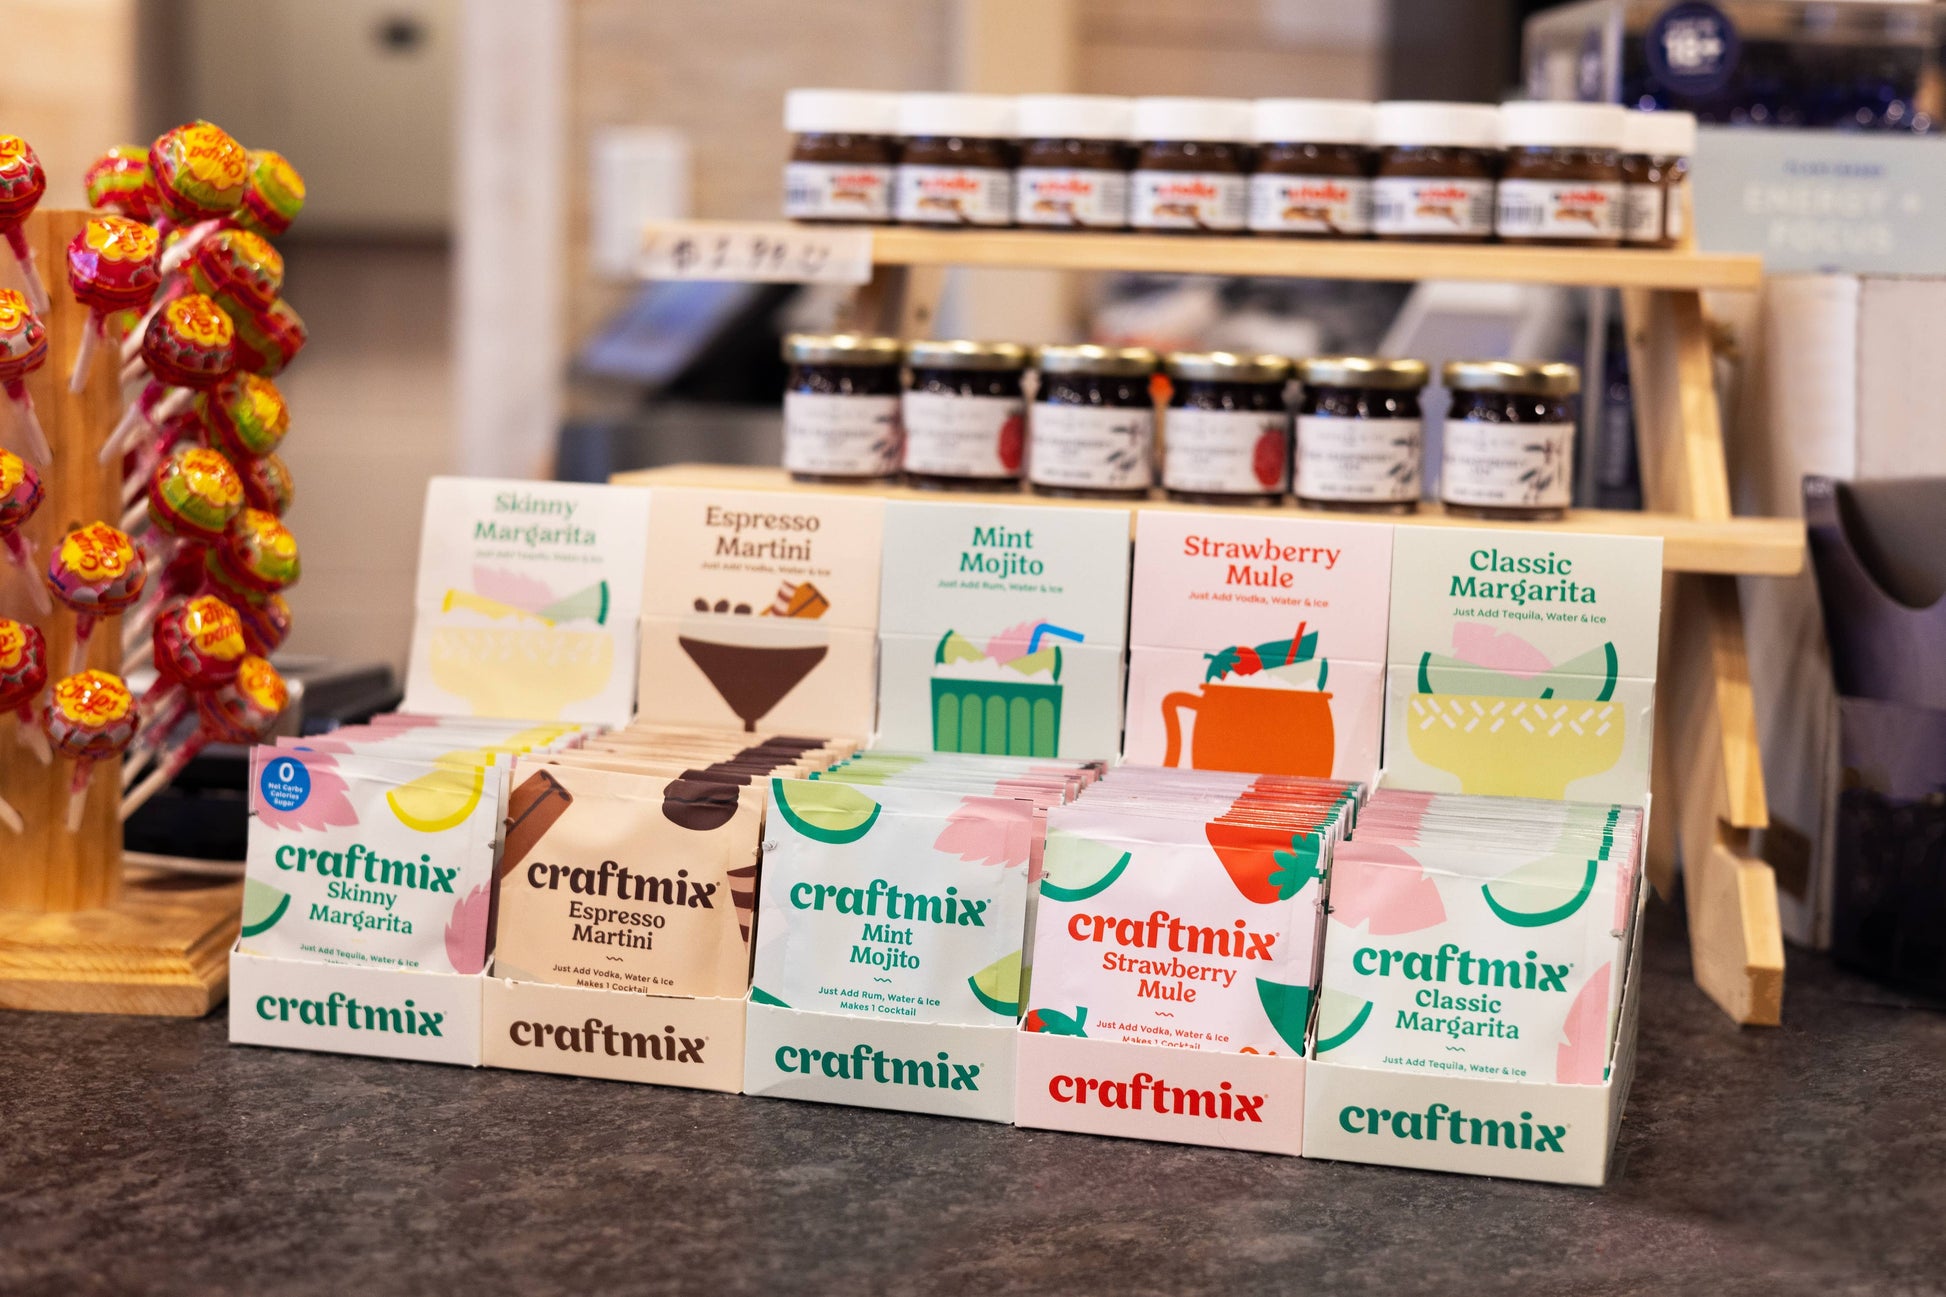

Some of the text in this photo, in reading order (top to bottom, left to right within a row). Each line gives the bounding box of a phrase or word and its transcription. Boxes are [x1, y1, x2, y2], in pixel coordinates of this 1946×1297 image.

[494, 492, 579, 519] Skinny
[705, 506, 821, 533] Espresso
[474, 521, 596, 547] Margarita
[972, 526, 1034, 549] Mint
[715, 536, 811, 561] Martini
[1183, 535, 1342, 570] Strawberry
[959, 552, 1044, 579] Mojito
[1470, 548, 1573, 576] Classic
[960, 580, 979, 590] Add
[1009, 583, 1037, 592] Water
[1225, 564, 1294, 589] Mule
[1189, 592, 1329, 607] Just Add Vodka, Water & Ice
[1449, 575, 1597, 606] Margarita
[1453, 608, 1607, 624] Just Add Tequila, Water & Ice
[279, 762, 295, 783] 0
[270, 790, 299, 800] Calories
[275, 843, 457, 894] craftmix
[327, 881, 398, 911] Skinny
[527, 860, 717, 909] craftmix
[569, 901, 666, 929] Espresso
[790, 878, 987, 927] craftmix
[309, 903, 413, 933] Margarita
[572, 924, 653, 950] Martini
[861, 923, 913, 946] Mint
[1068, 910, 1276, 961] craftmix
[300, 944, 316, 952] Just
[318, 947, 335, 955] Add
[370, 955, 395, 964] Water
[406, 960, 419, 968] Ice
[849, 945, 920, 971] Mojito
[1353, 943, 1569, 992] craftmix
[553, 964, 570, 973] Just
[573, 967, 591, 975] Add
[593, 969, 622, 980] Vodka,
[625, 973, 650, 982] Water
[661, 977, 674, 986] Ice
[1102, 951, 1237, 988] Strawberry
[576, 979, 603, 989] Makes
[612, 983, 648, 993] Cocktail
[818, 986, 941, 1006] Just Add Rum, Water & Ice
[1137, 979, 1197, 1003] Mule
[840, 1001, 869, 1011] Makes
[878, 1005, 916, 1016] Cocktail
[1415, 988, 1502, 1014] Classic
[256, 992, 444, 1037] craftmix
[1395, 1010, 1520, 1040] Margarita
[509, 1018, 706, 1064] craftmix
[1097, 1021, 1229, 1042] Just Add Vodka, Water & Ice
[775, 1044, 980, 1091] craftmix
[1383, 1056, 1527, 1077] Just Add Tequila, Water & Ice
[1048, 1072, 1264, 1123] craftmix
[1339, 1103, 1566, 1153] craftmix
